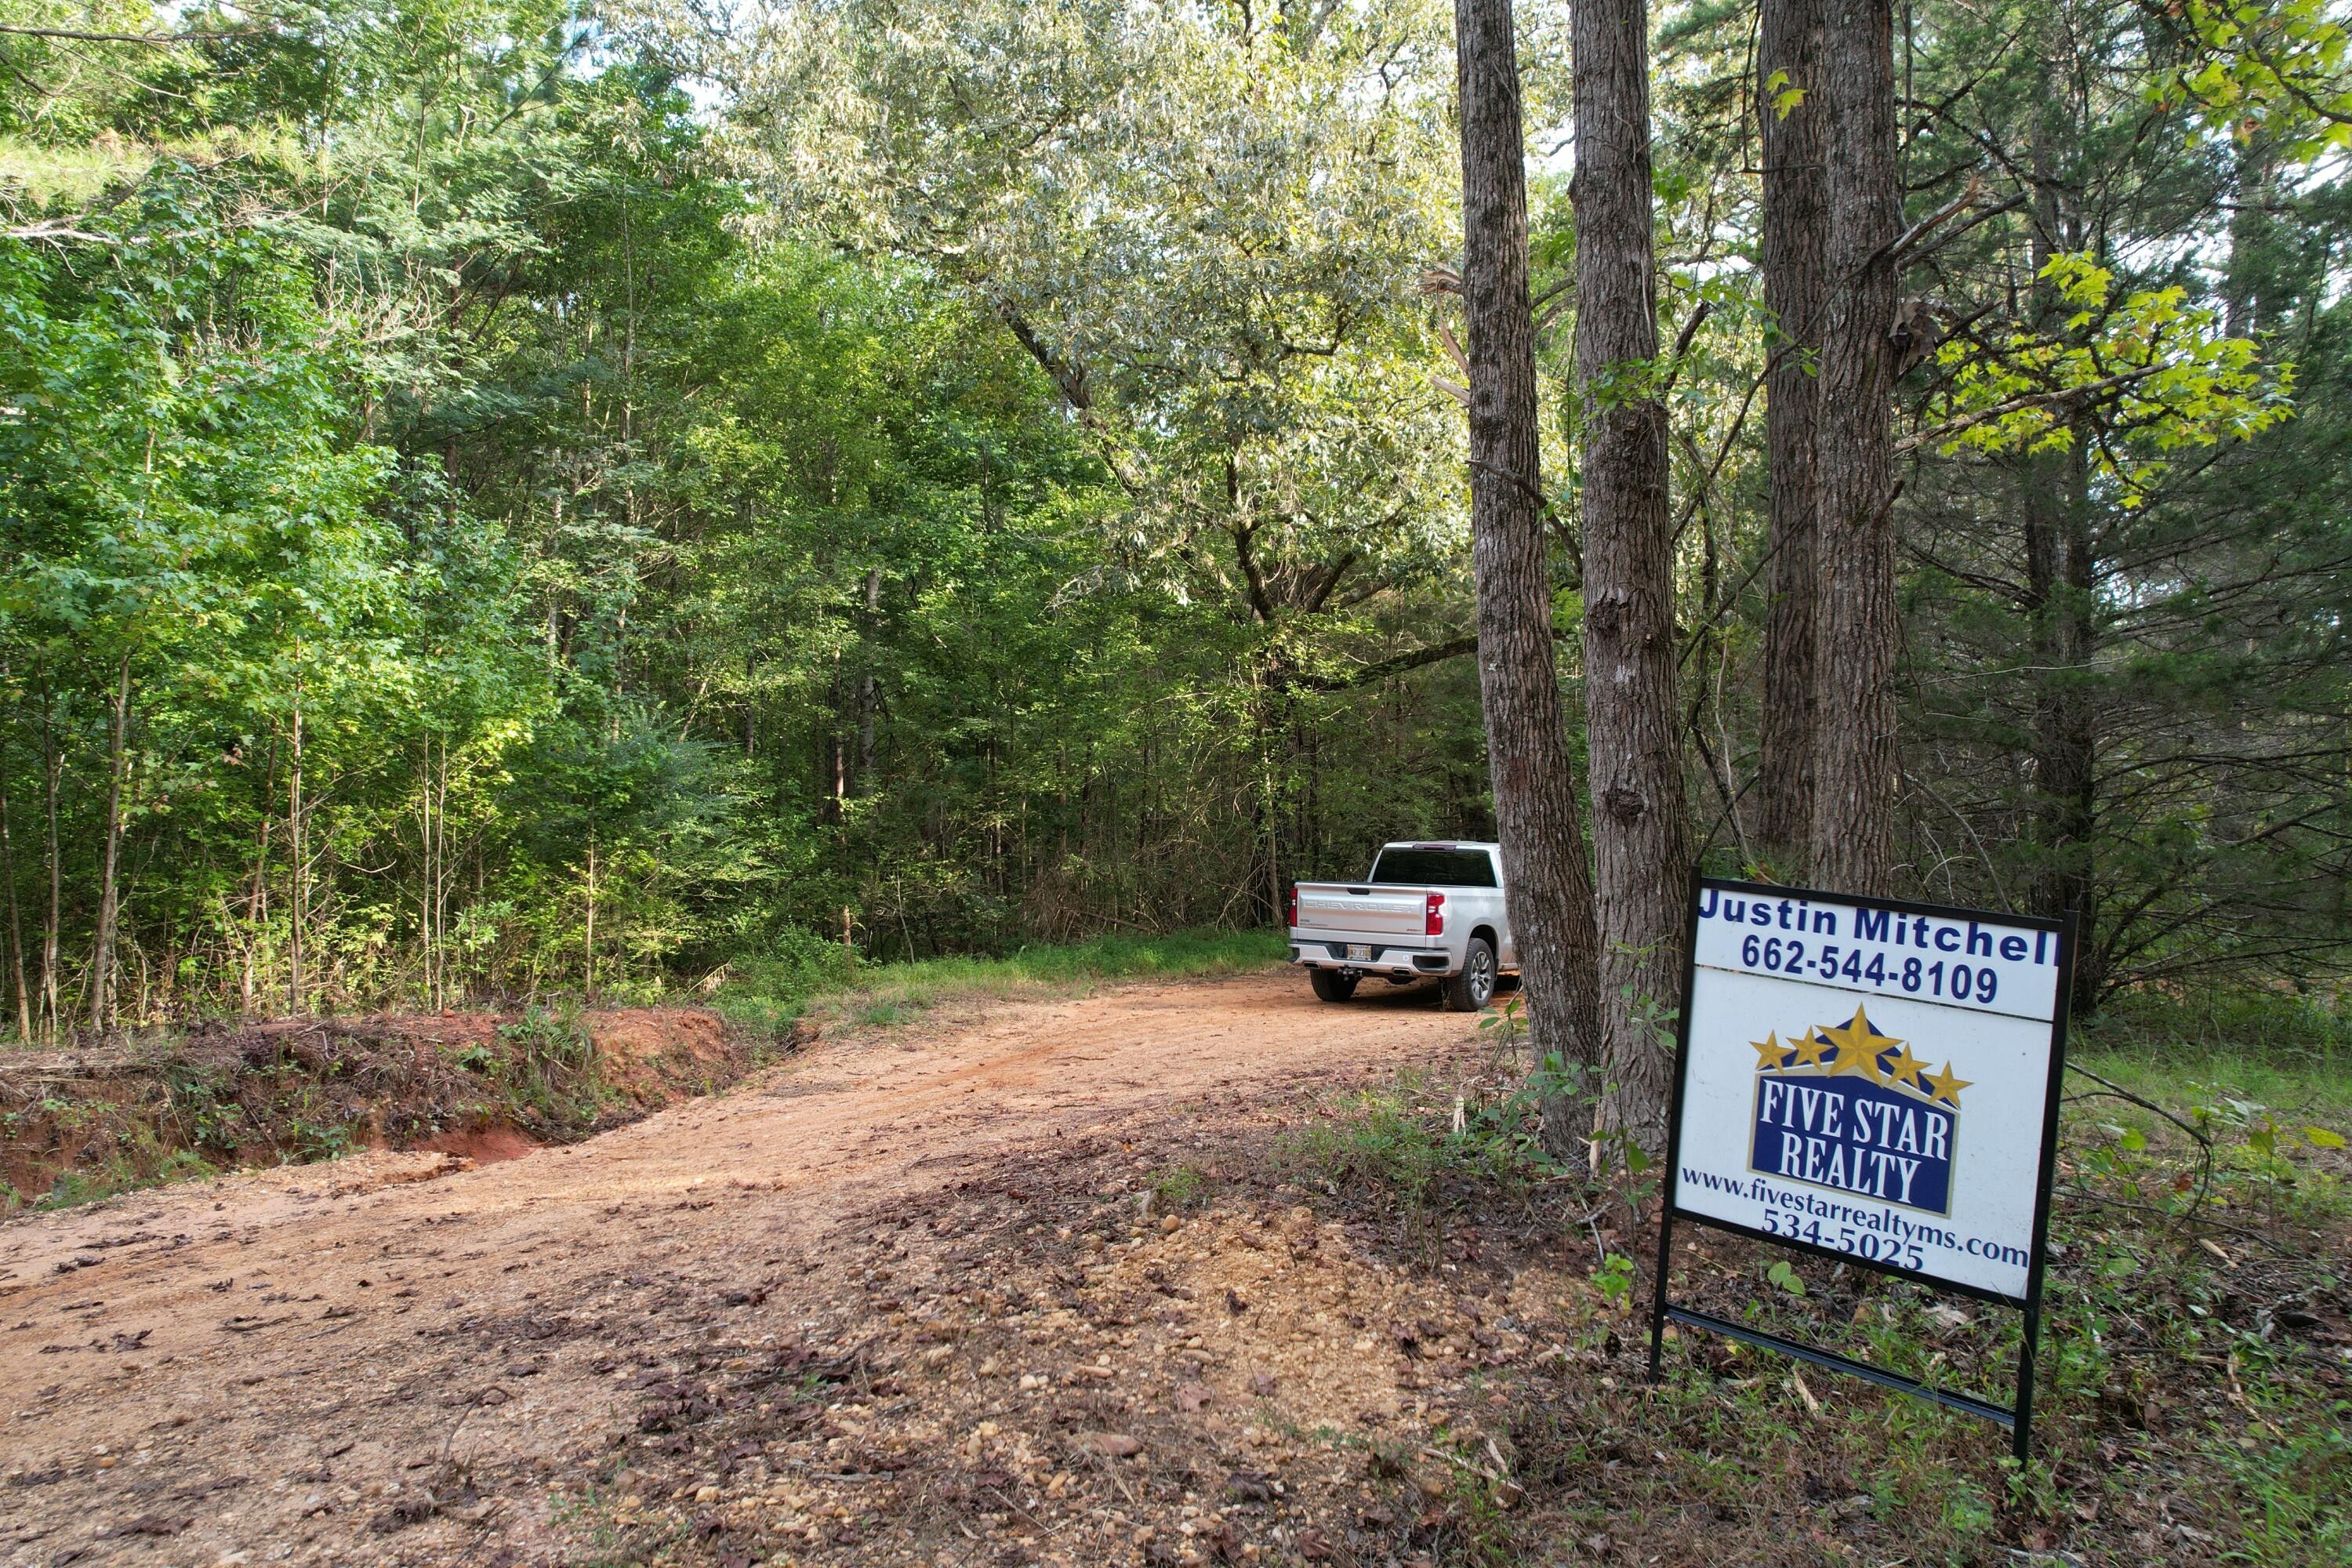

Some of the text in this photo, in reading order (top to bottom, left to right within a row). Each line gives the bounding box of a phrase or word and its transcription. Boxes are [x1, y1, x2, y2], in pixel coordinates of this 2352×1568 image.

[1304, 901, 1415, 913] CHEVROLET
[1698, 889, 1837, 936] Justin
[1742, 934, 1998, 1004] 662-544-8109
[1759, 1079, 1949, 1161] FIVE STAR
[1777, 1131, 1922, 1204] REALTY
[1682, 1167, 2028, 1269] www.fivestarrealtyms.com
[1761, 1208, 1924, 1271] 534-5025
